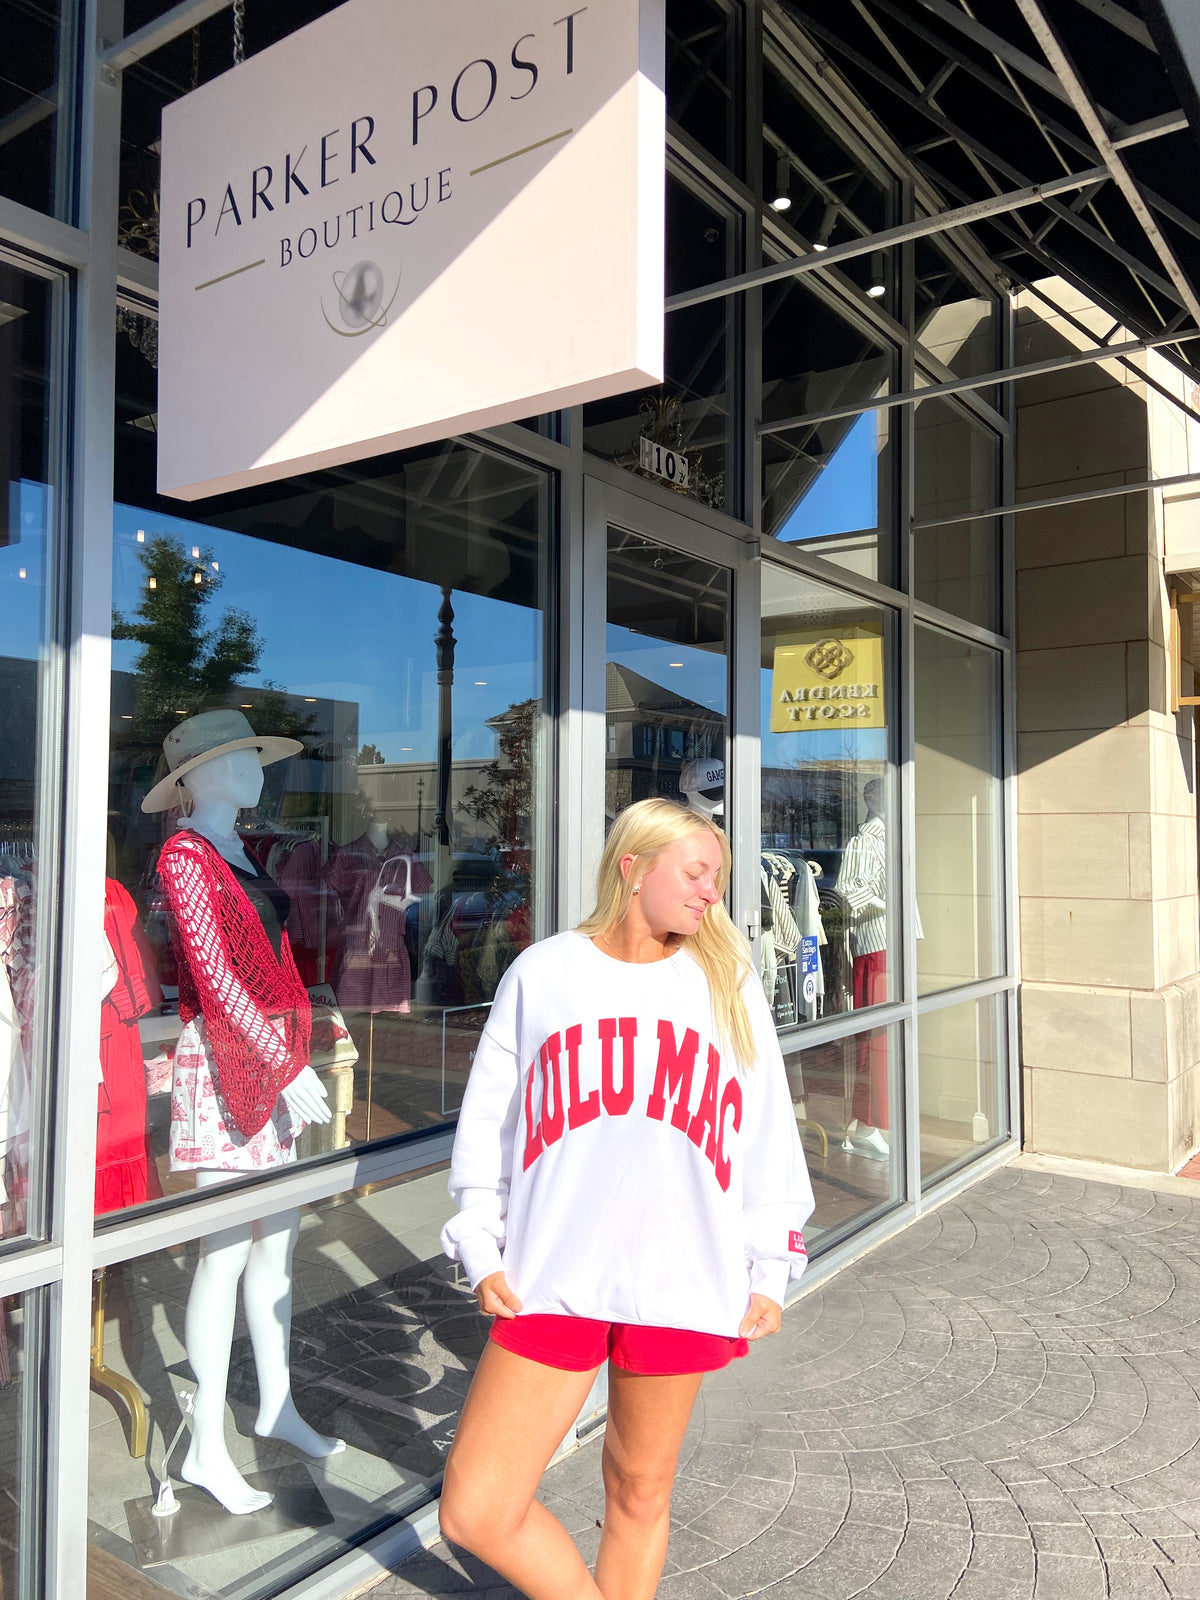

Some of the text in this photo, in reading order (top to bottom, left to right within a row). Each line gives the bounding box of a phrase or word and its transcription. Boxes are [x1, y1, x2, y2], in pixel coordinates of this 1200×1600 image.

[186, 6, 589, 249] PARKER POST
[279, 166, 454, 268] BOUTIQUE
[523, 1017, 743, 1194] LULU MAC
